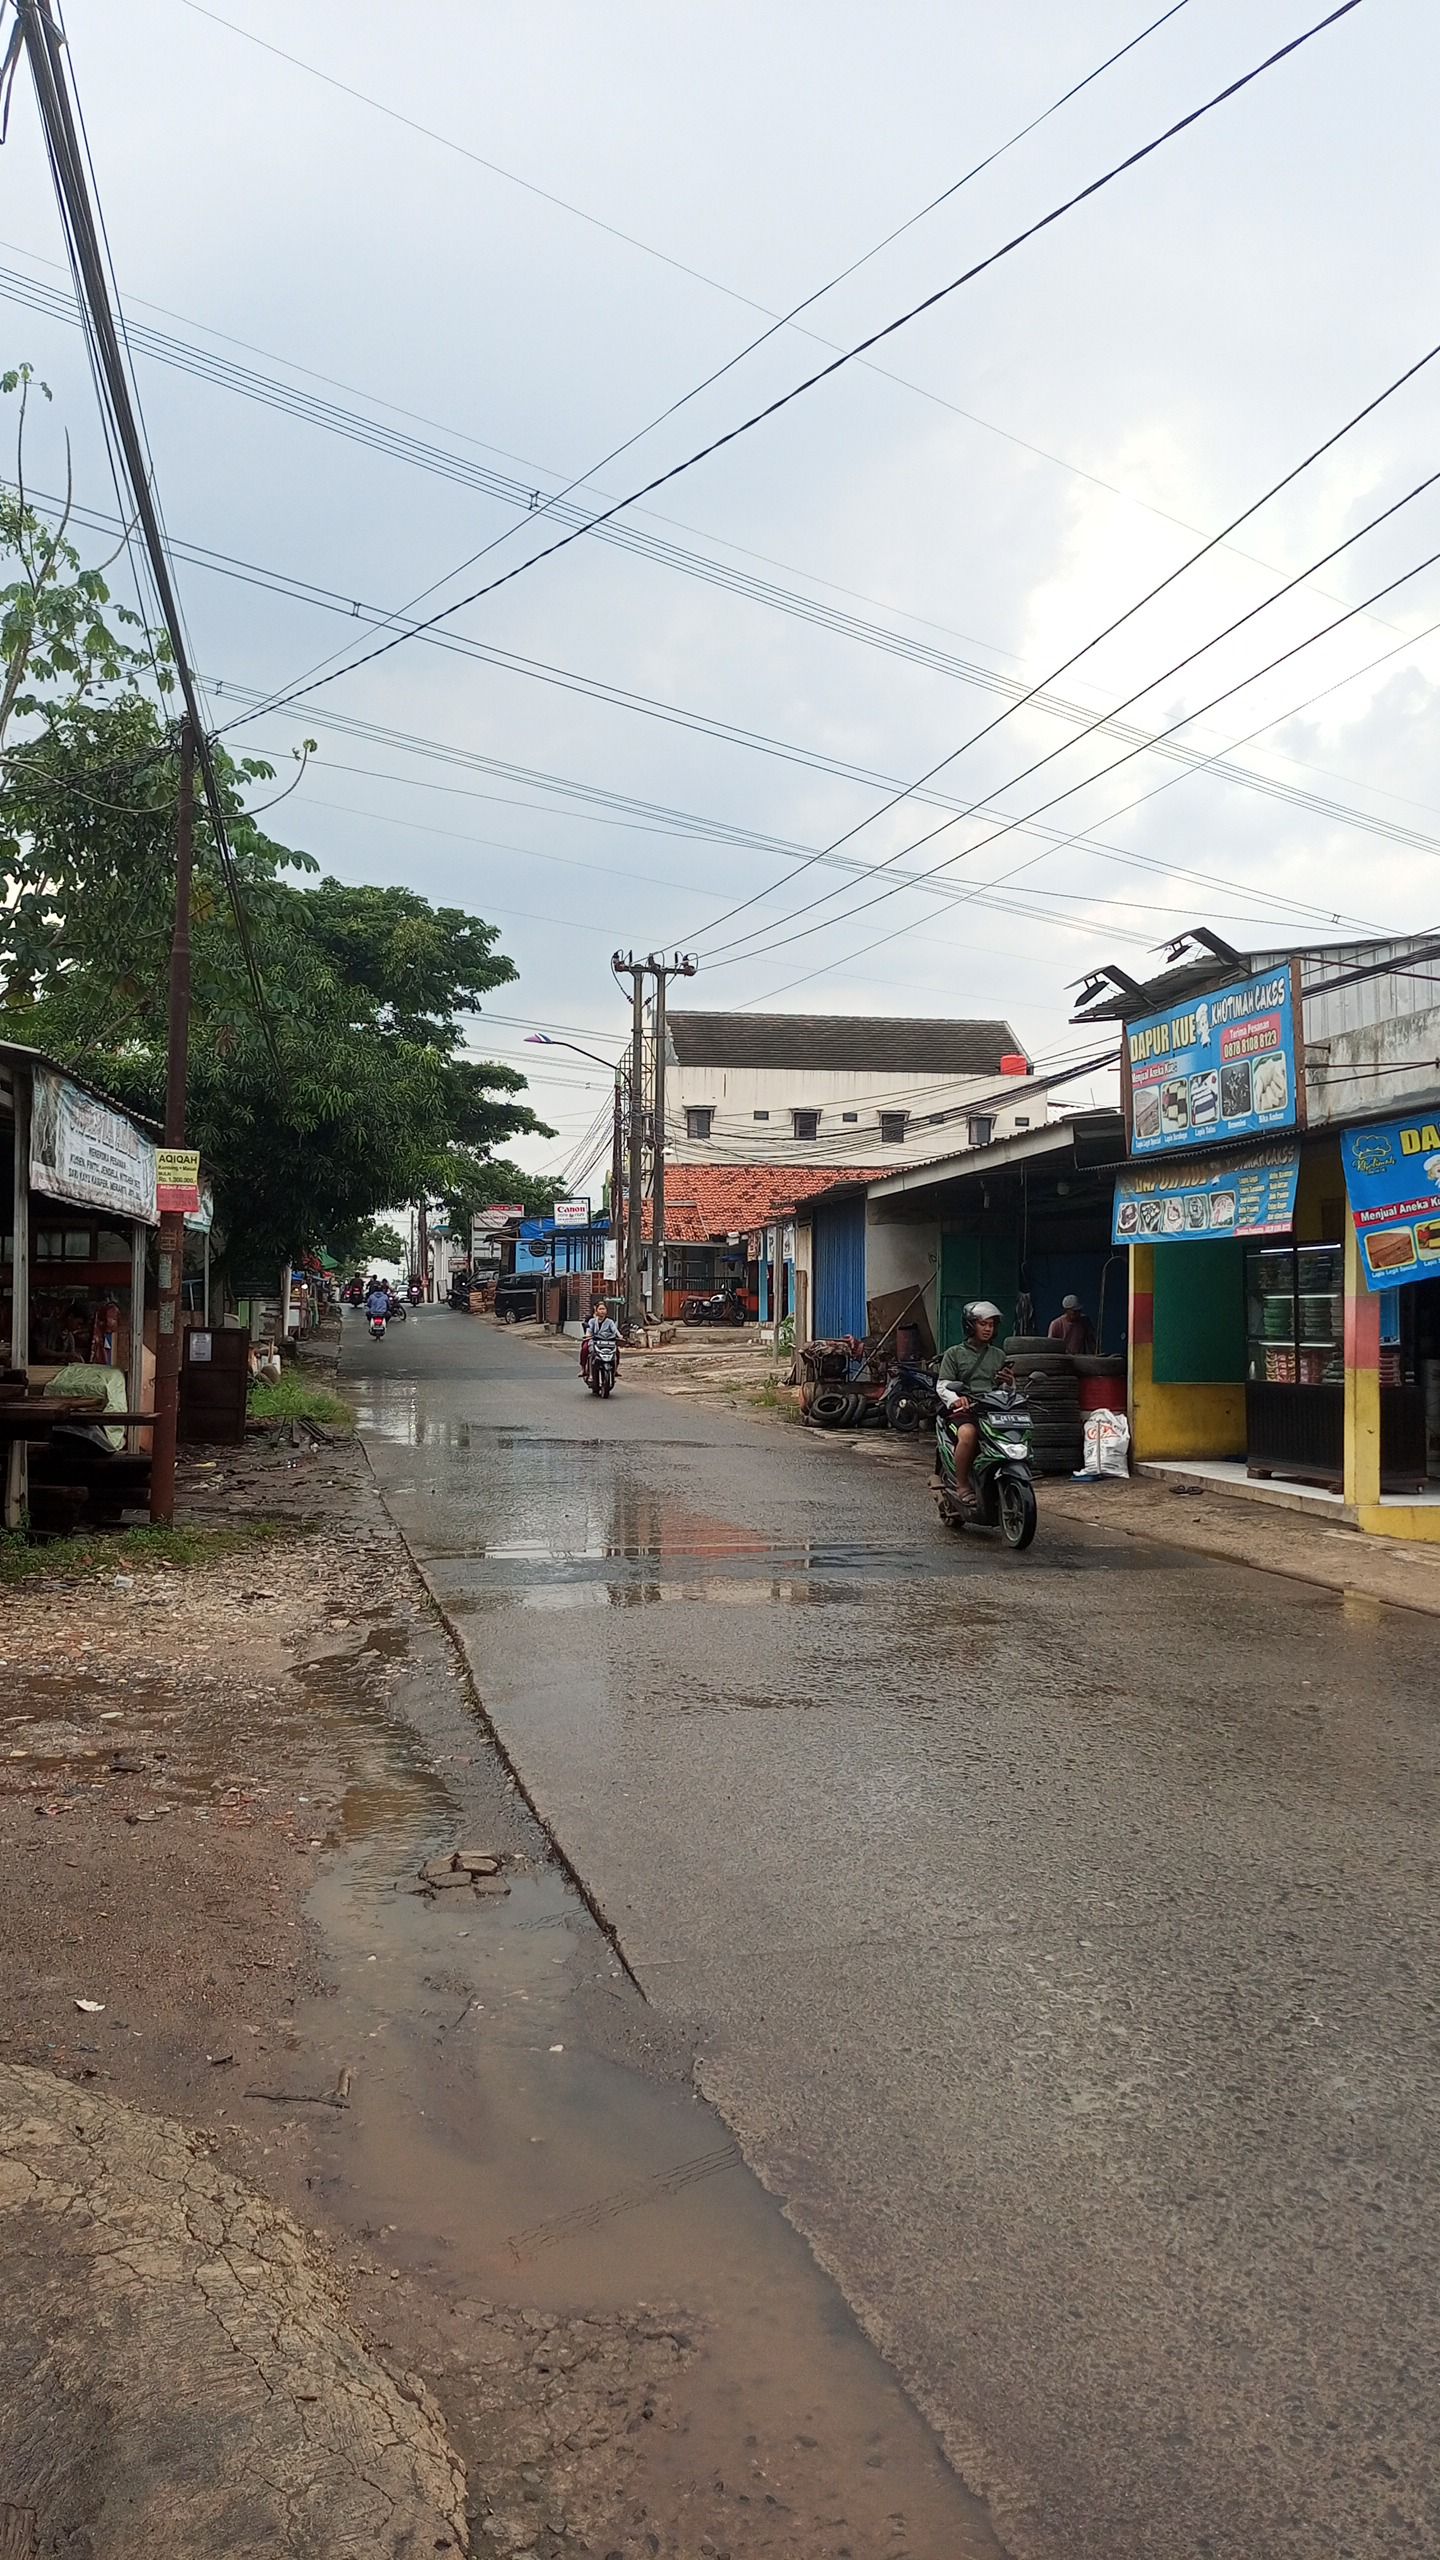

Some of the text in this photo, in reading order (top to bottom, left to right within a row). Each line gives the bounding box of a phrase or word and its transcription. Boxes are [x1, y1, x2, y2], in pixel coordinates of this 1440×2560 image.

[1211, 977, 1285, 1026] KHOTIMAH CAKES
[1130, 1013, 1197, 1063] DAPUR KUE
[1224, 1040, 1241, 1059] 0878
[1259, 1029, 1277, 1052] 8123
[1400, 1122, 1440, 1157] DA
[158, 1154, 198, 1164] AQIQAH
[1361, 1205, 1397, 1224] Menjual
[1399, 1198, 1429, 1215] Aneka
